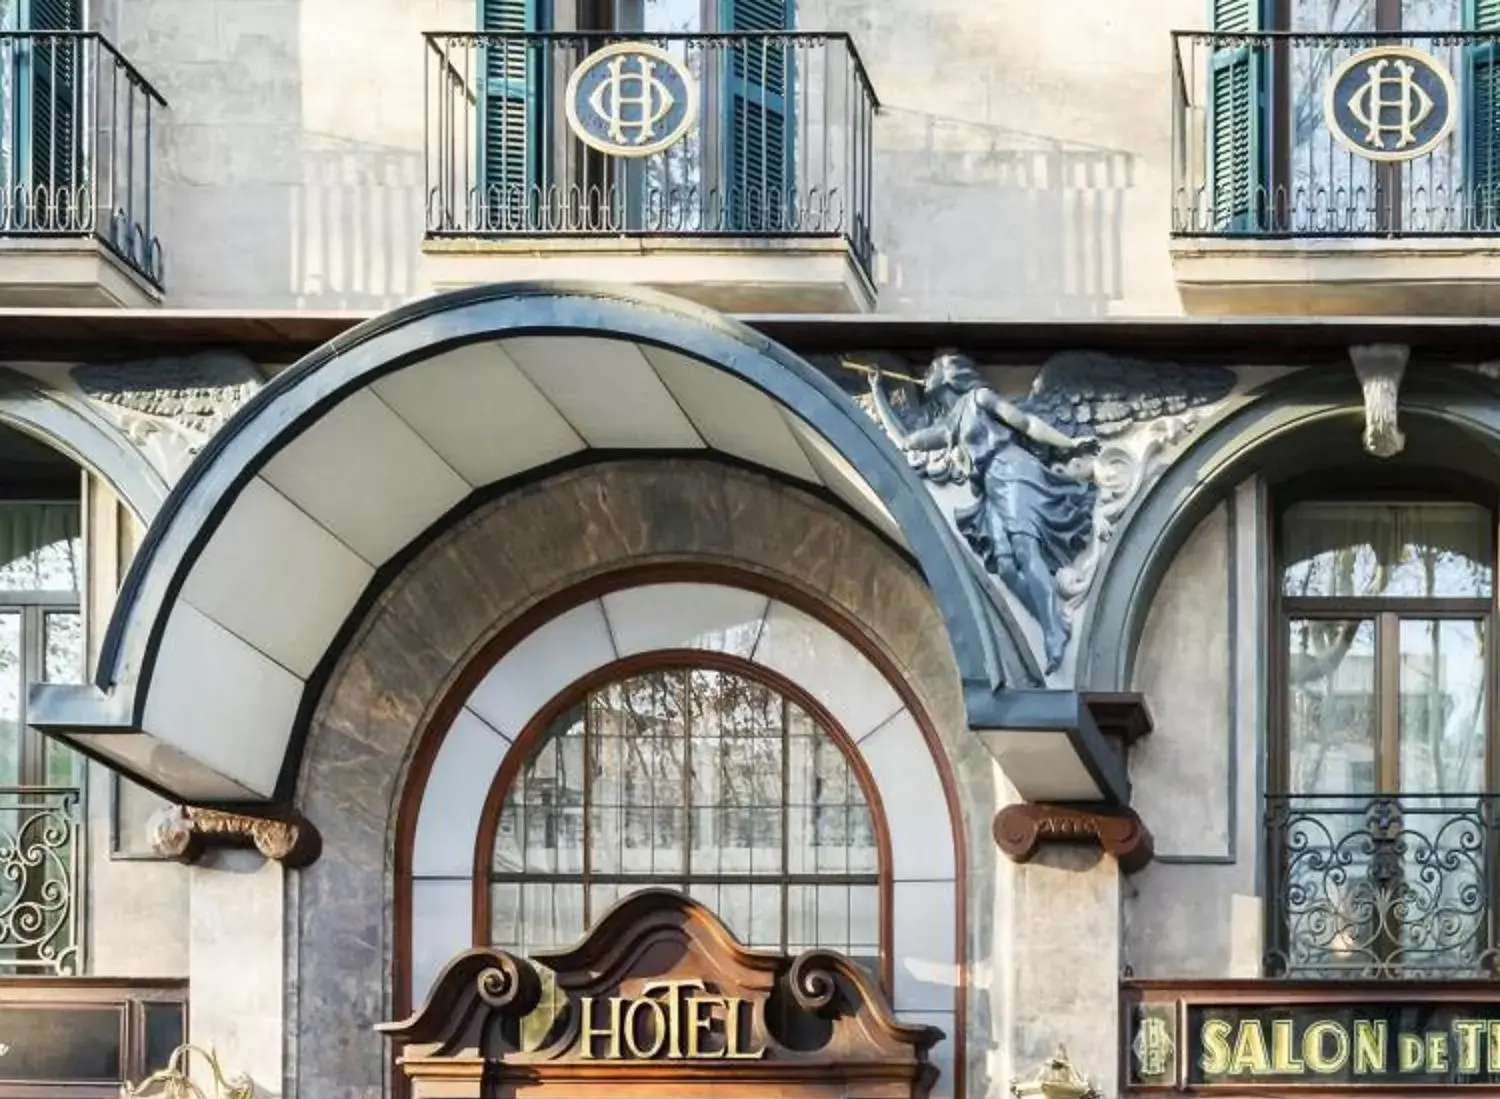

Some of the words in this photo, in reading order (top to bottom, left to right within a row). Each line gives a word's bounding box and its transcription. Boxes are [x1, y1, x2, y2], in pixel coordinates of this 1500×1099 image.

[579, 978, 767, 1060] HOTEL
[1201, 1018, 1388, 1075] SALON
[1399, 1031, 1449, 1074] DE
